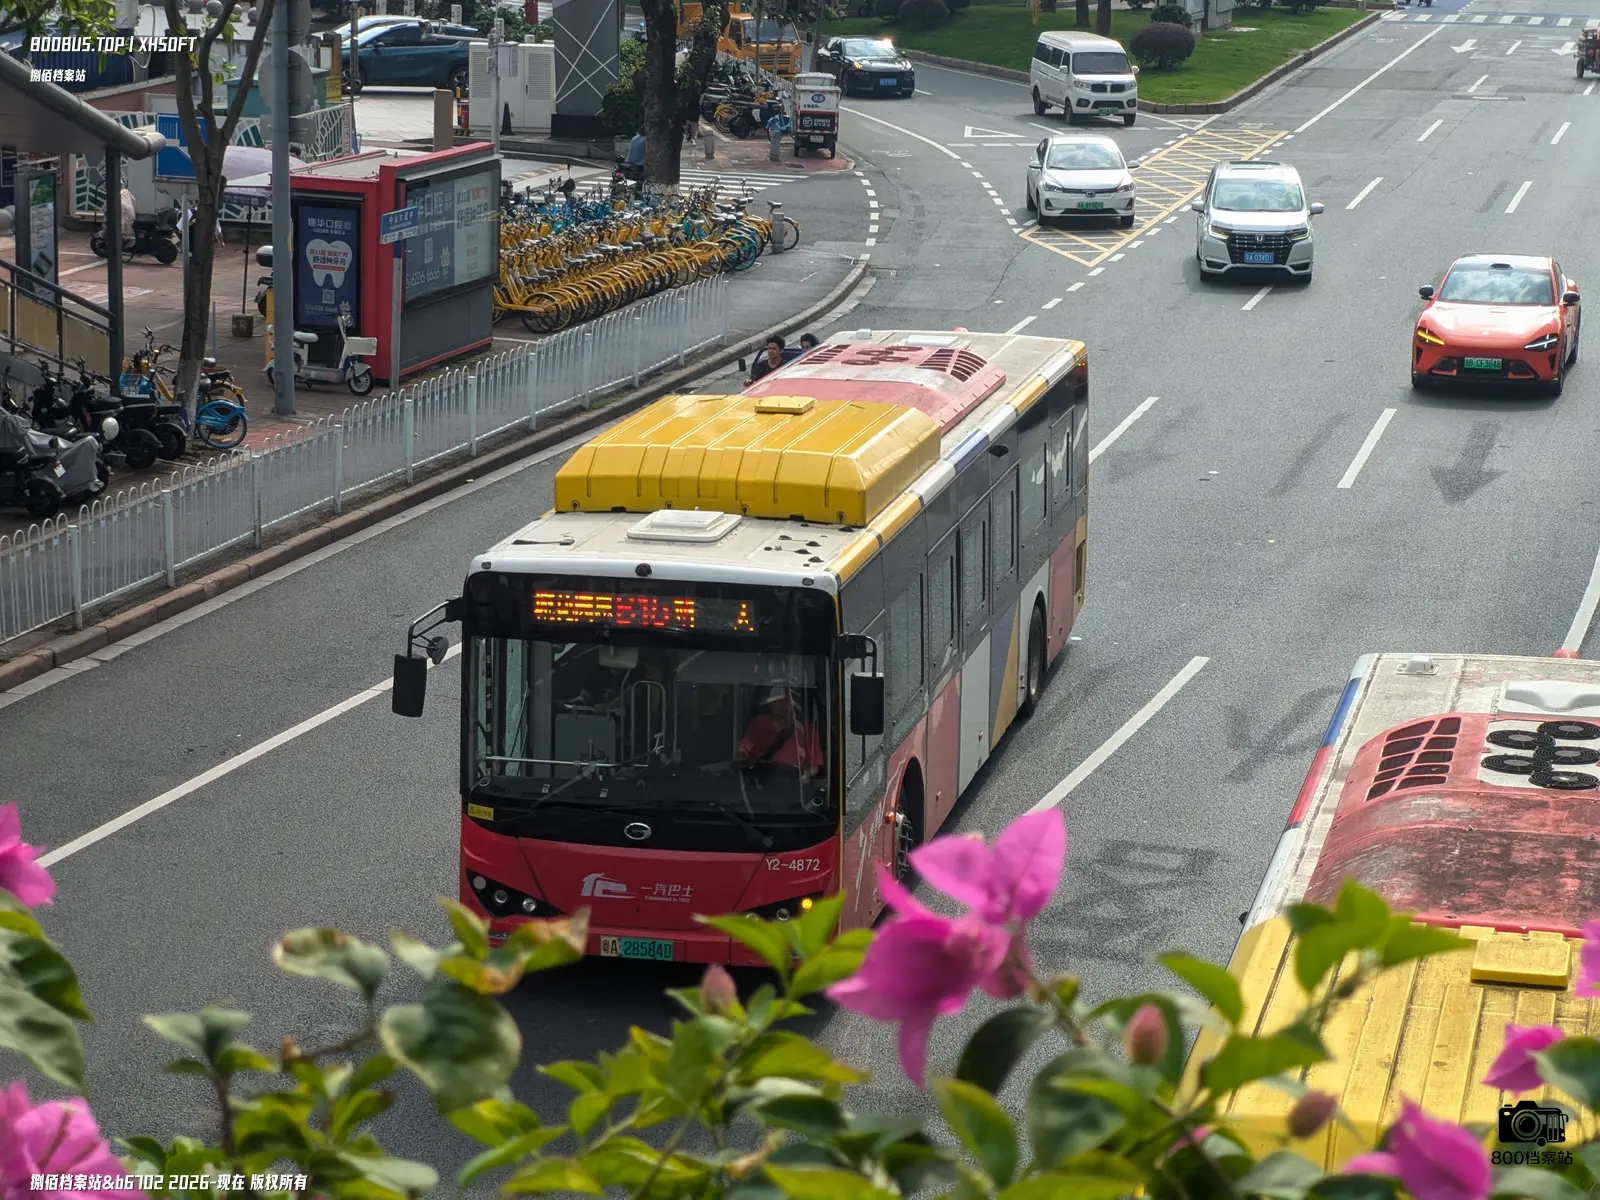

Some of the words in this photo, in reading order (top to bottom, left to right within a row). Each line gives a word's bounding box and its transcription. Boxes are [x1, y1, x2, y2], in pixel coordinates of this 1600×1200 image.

[766, 859, 820, 871] Y2-4872
[640, 883, 694, 898] 一汽巴士
[623, 940, 672, 959] 28584D
